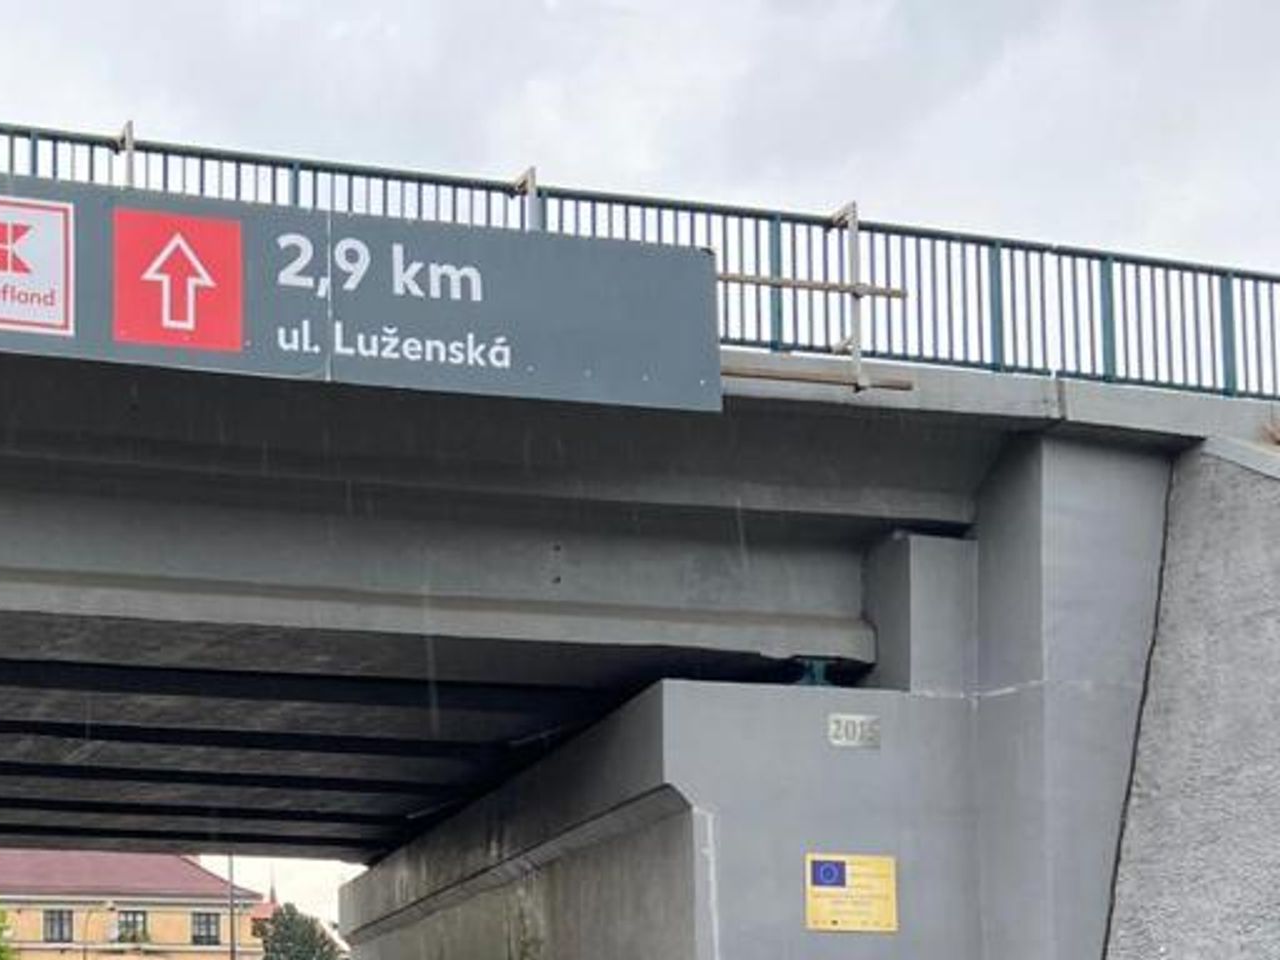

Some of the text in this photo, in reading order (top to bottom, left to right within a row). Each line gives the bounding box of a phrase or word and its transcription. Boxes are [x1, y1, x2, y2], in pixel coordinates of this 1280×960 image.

[276, 233, 483, 302] 2,9 km
[277, 320, 511, 368] ul. Luženská
